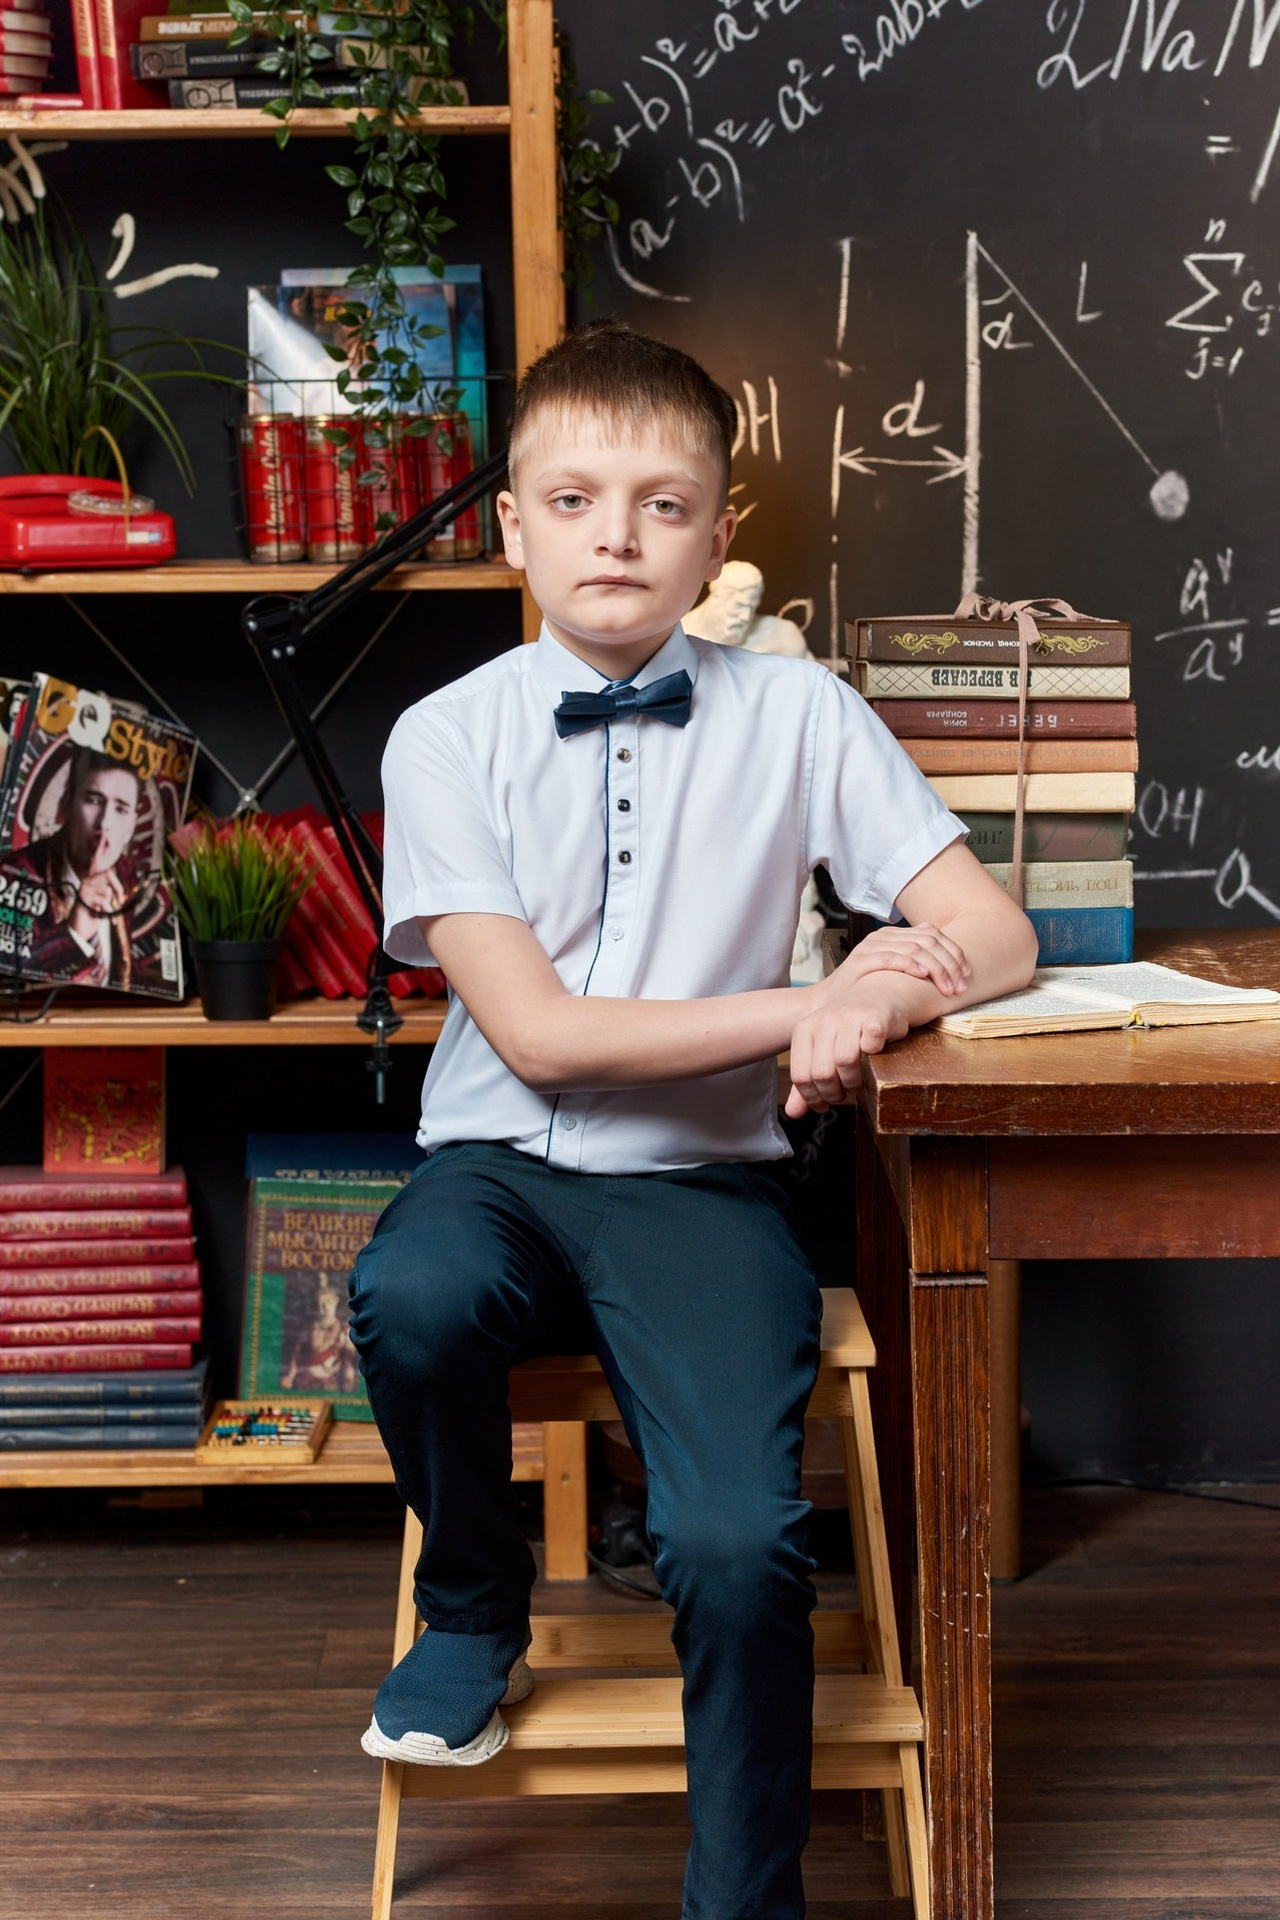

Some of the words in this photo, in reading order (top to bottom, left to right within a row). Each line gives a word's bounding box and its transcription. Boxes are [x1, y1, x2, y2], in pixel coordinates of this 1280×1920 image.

[260, 427, 280, 469] Cola
[963, 639, 994, 647] ПАСЕНЮК
[997, 640, 1020, 648] ЕОНИД
[930, 669, 1004, 688] ВЕРЕСАЕВ
[926, 710, 968, 719] БОНДАРЕВ
[943, 719, 968, 728] ЮРИЙ
[105, 719, 190, 780] Style
[283, 1212, 375, 1232] ВЕЛИКИЕ
